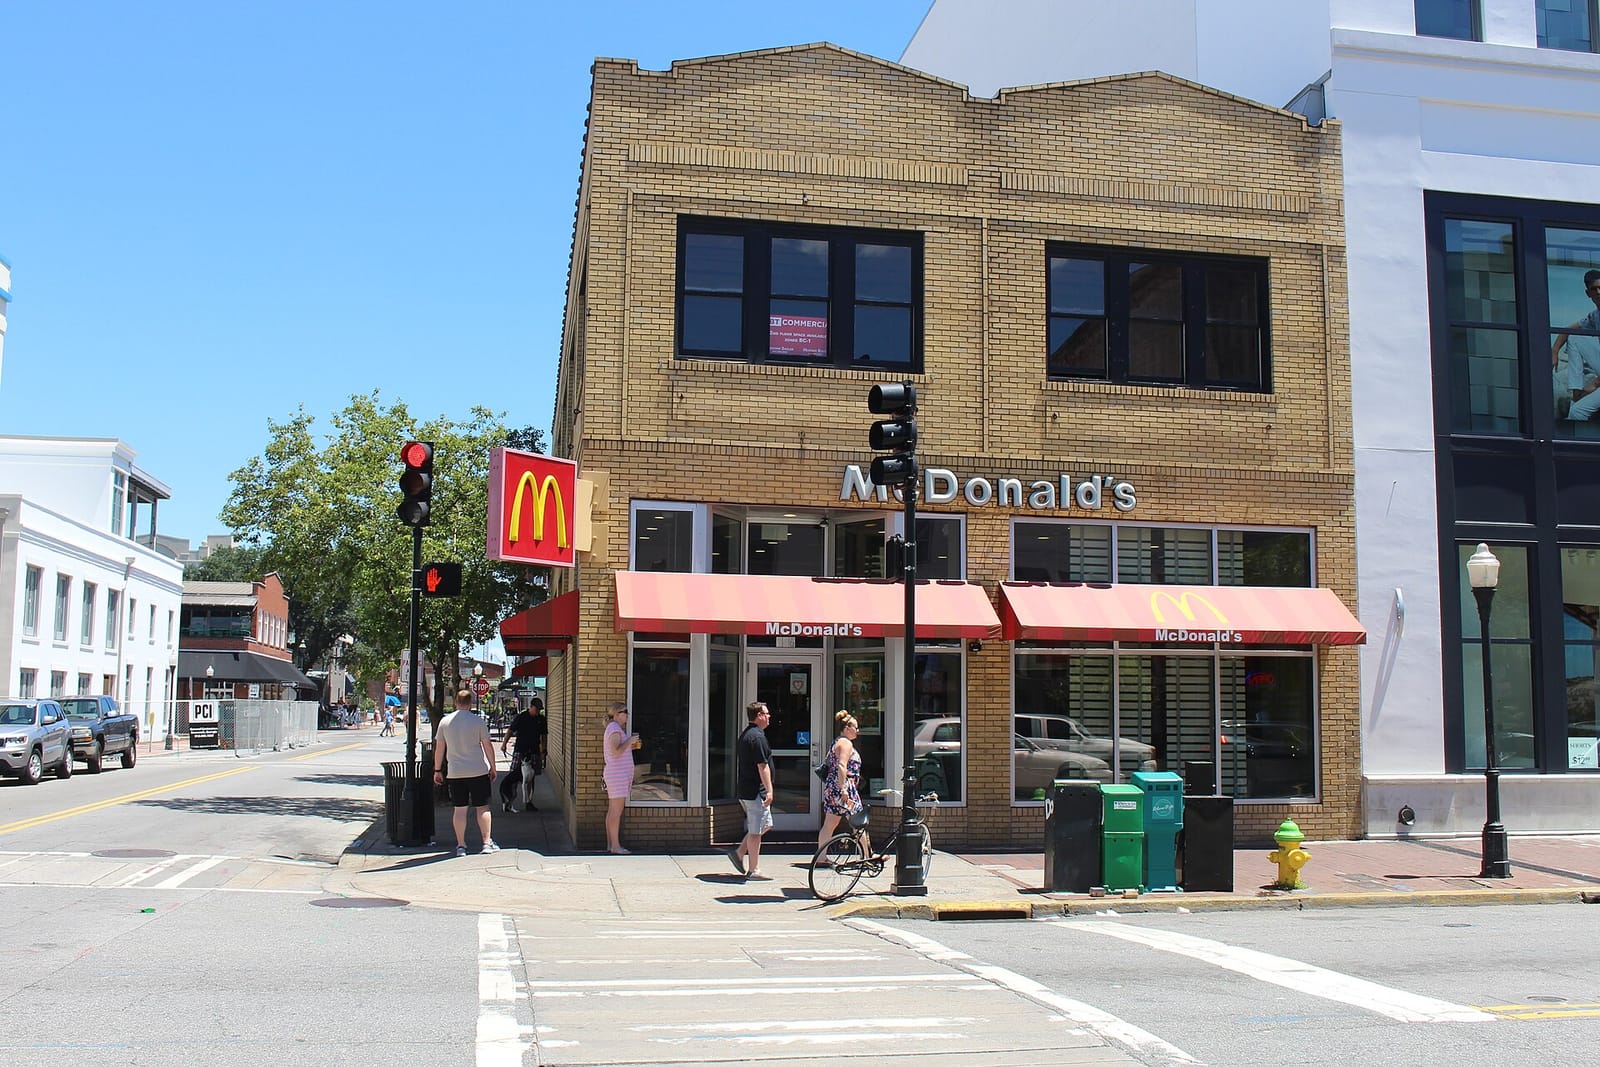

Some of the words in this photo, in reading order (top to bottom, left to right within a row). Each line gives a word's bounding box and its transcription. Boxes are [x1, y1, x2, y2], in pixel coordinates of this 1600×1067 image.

[765, 622, 863, 636] McDonald's
[1155, 629, 1243, 642] McDonald's
[194, 704, 213, 719] PCI
